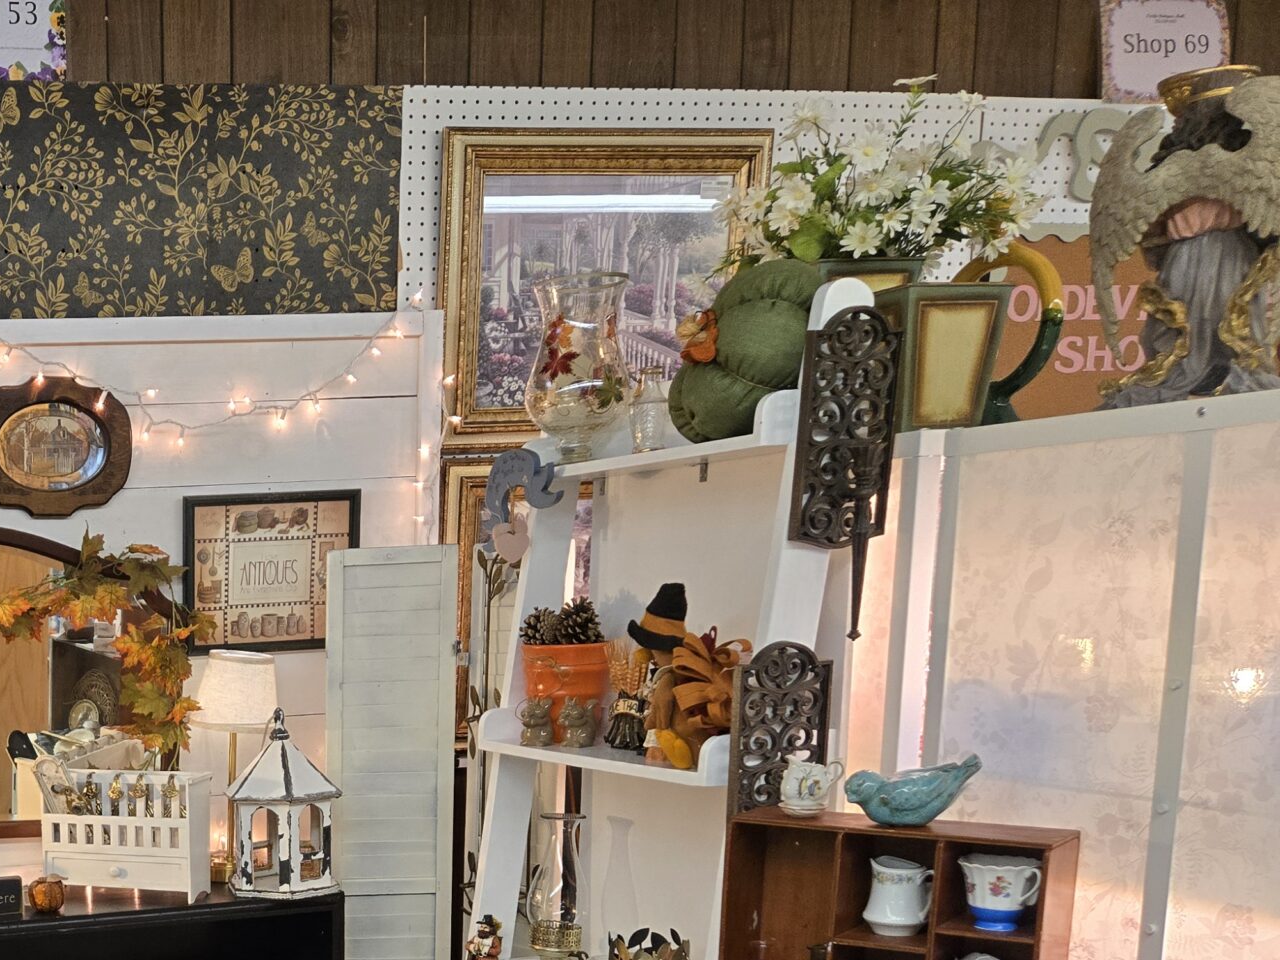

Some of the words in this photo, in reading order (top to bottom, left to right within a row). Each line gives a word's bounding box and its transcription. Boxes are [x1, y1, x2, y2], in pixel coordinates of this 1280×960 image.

[8, 1, 38, 25] 53
[1123, 33, 1176, 57] Shop
[1184, 34, 1210, 54] 69
[240, 559, 298, 586] ANTIQUES
